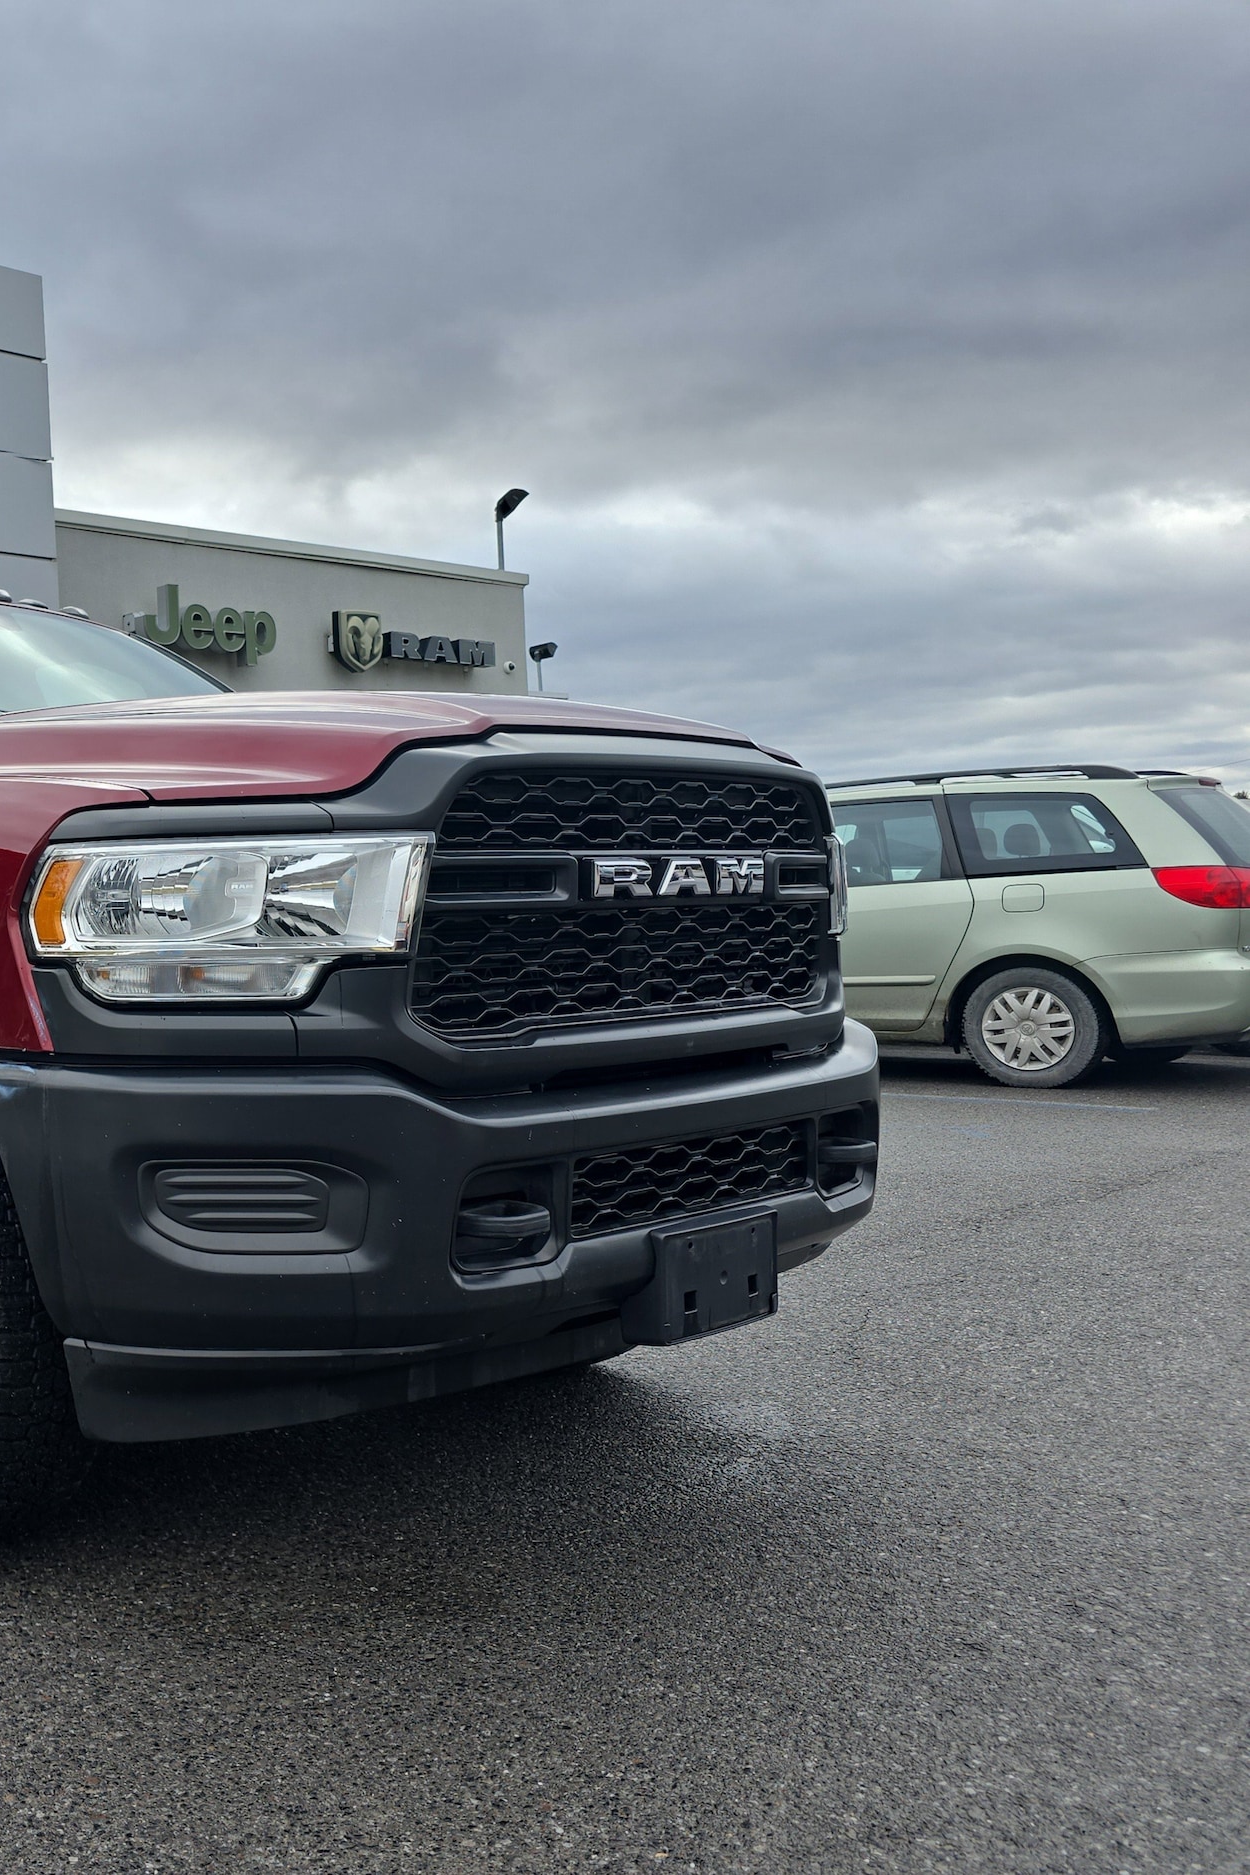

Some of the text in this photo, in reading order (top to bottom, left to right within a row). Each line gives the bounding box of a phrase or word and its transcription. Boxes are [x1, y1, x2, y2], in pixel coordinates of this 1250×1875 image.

[138, 584, 277, 667] Jeep
[385, 630, 496, 669] RAM
[592, 856, 765, 898] RAM
